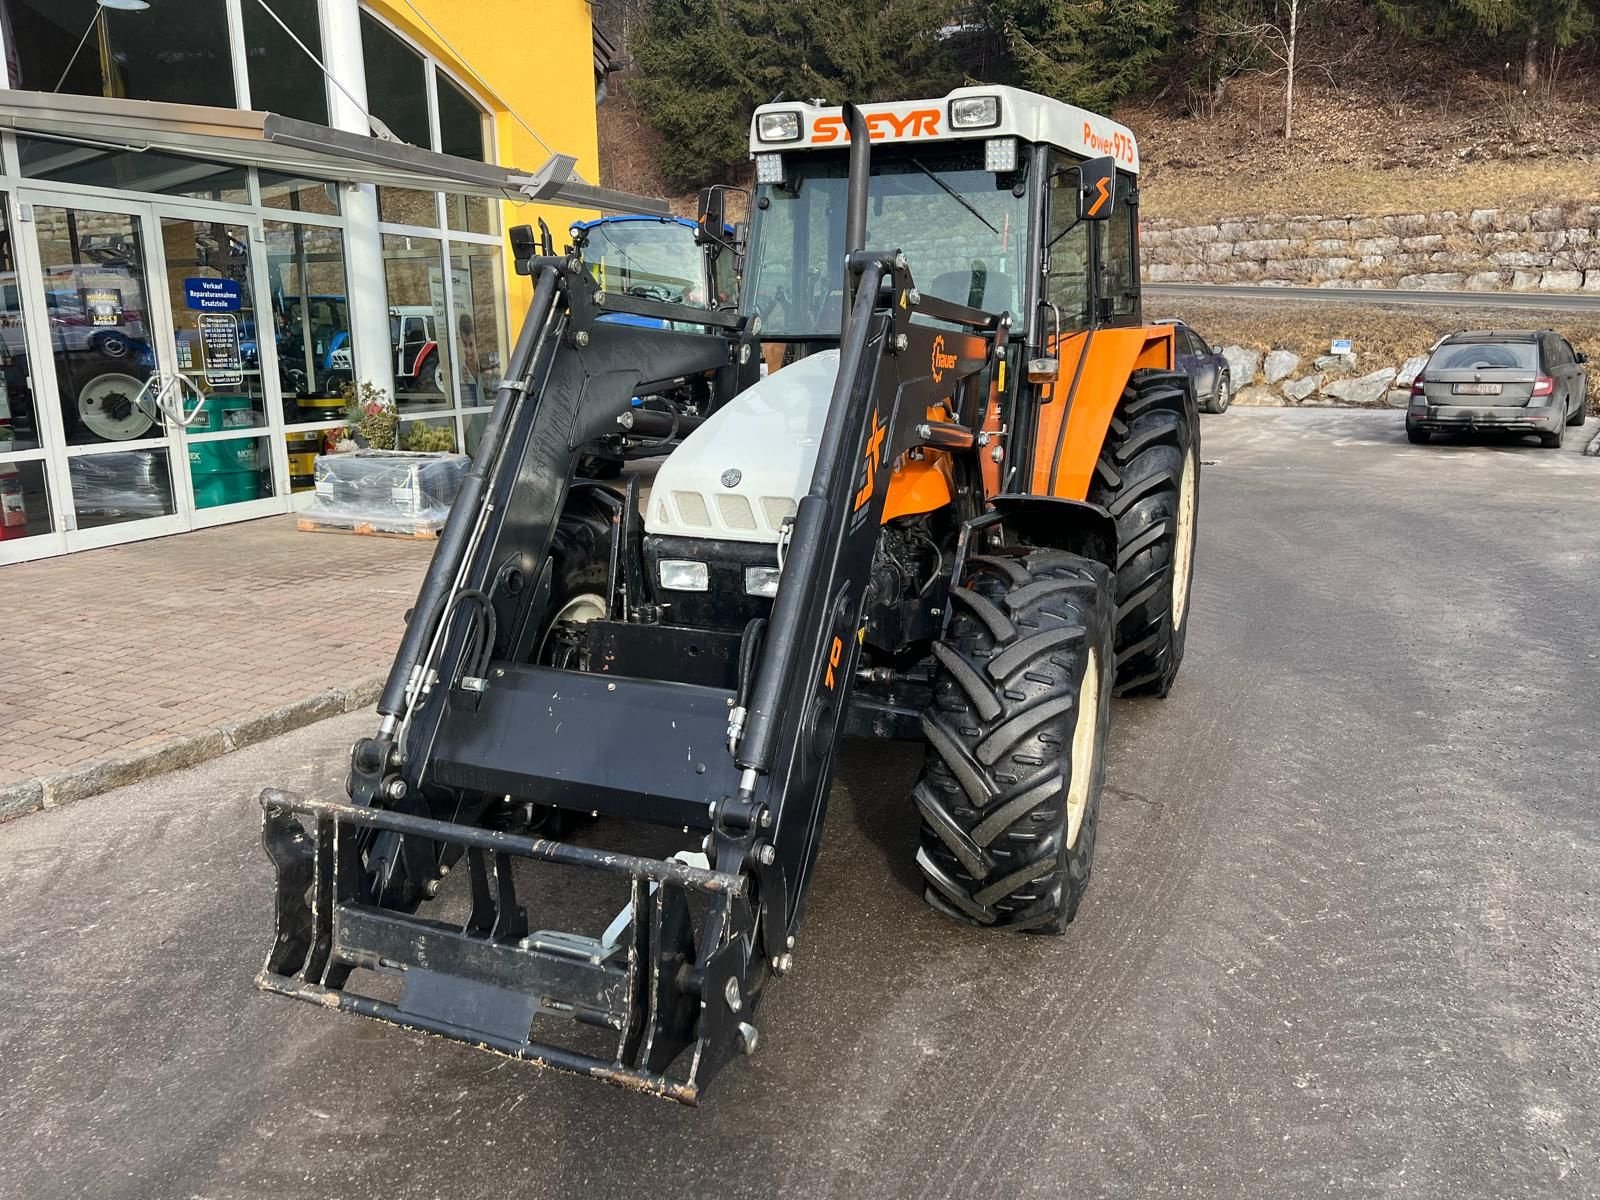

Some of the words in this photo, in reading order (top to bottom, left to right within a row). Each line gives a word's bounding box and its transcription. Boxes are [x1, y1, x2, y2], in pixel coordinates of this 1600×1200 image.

[1083, 121, 1113, 155] Power
[1113, 131, 1134, 164] 975
[189, 290, 237, 299] Reparaturannahme
[935, 346, 958, 369] hauer
[824, 636, 842, 691] 70
